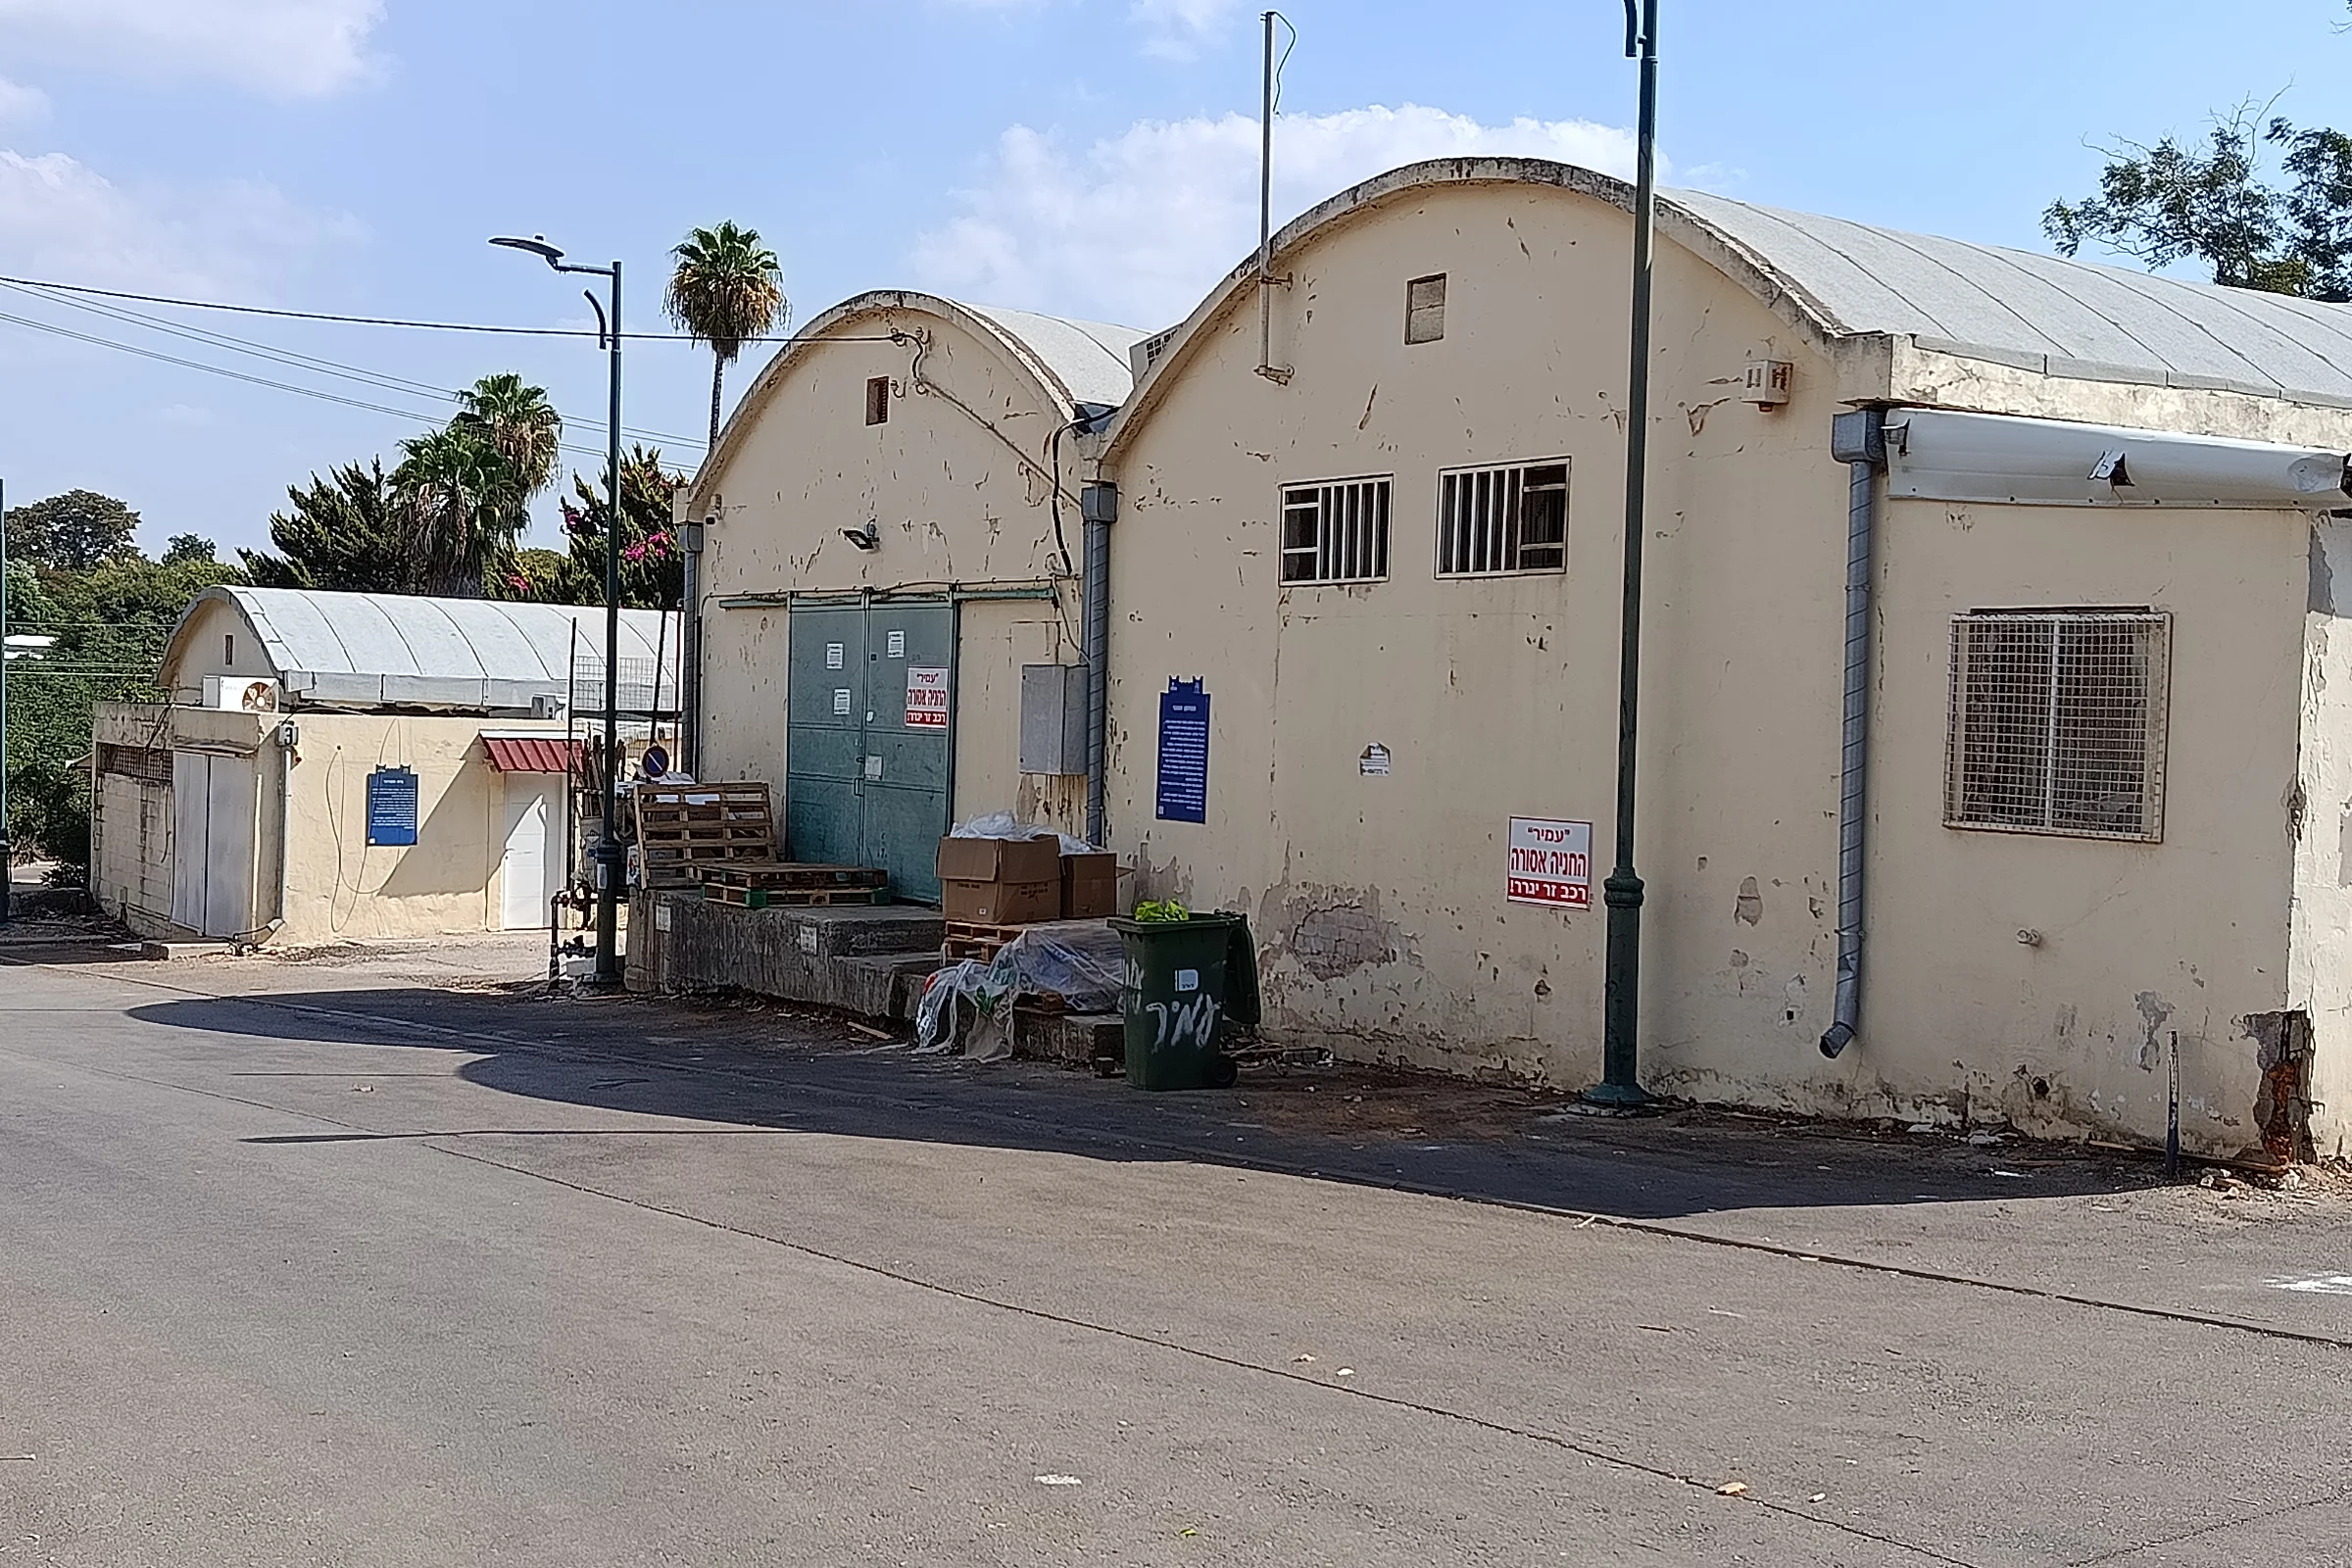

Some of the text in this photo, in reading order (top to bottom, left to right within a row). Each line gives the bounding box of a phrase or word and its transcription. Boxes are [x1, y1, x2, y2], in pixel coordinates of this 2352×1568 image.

[1510, 847, 1587, 878] החניה אסורה
[1542, 882, 1557, 898] זר
[1559, 884, 1587, 901] רכב
